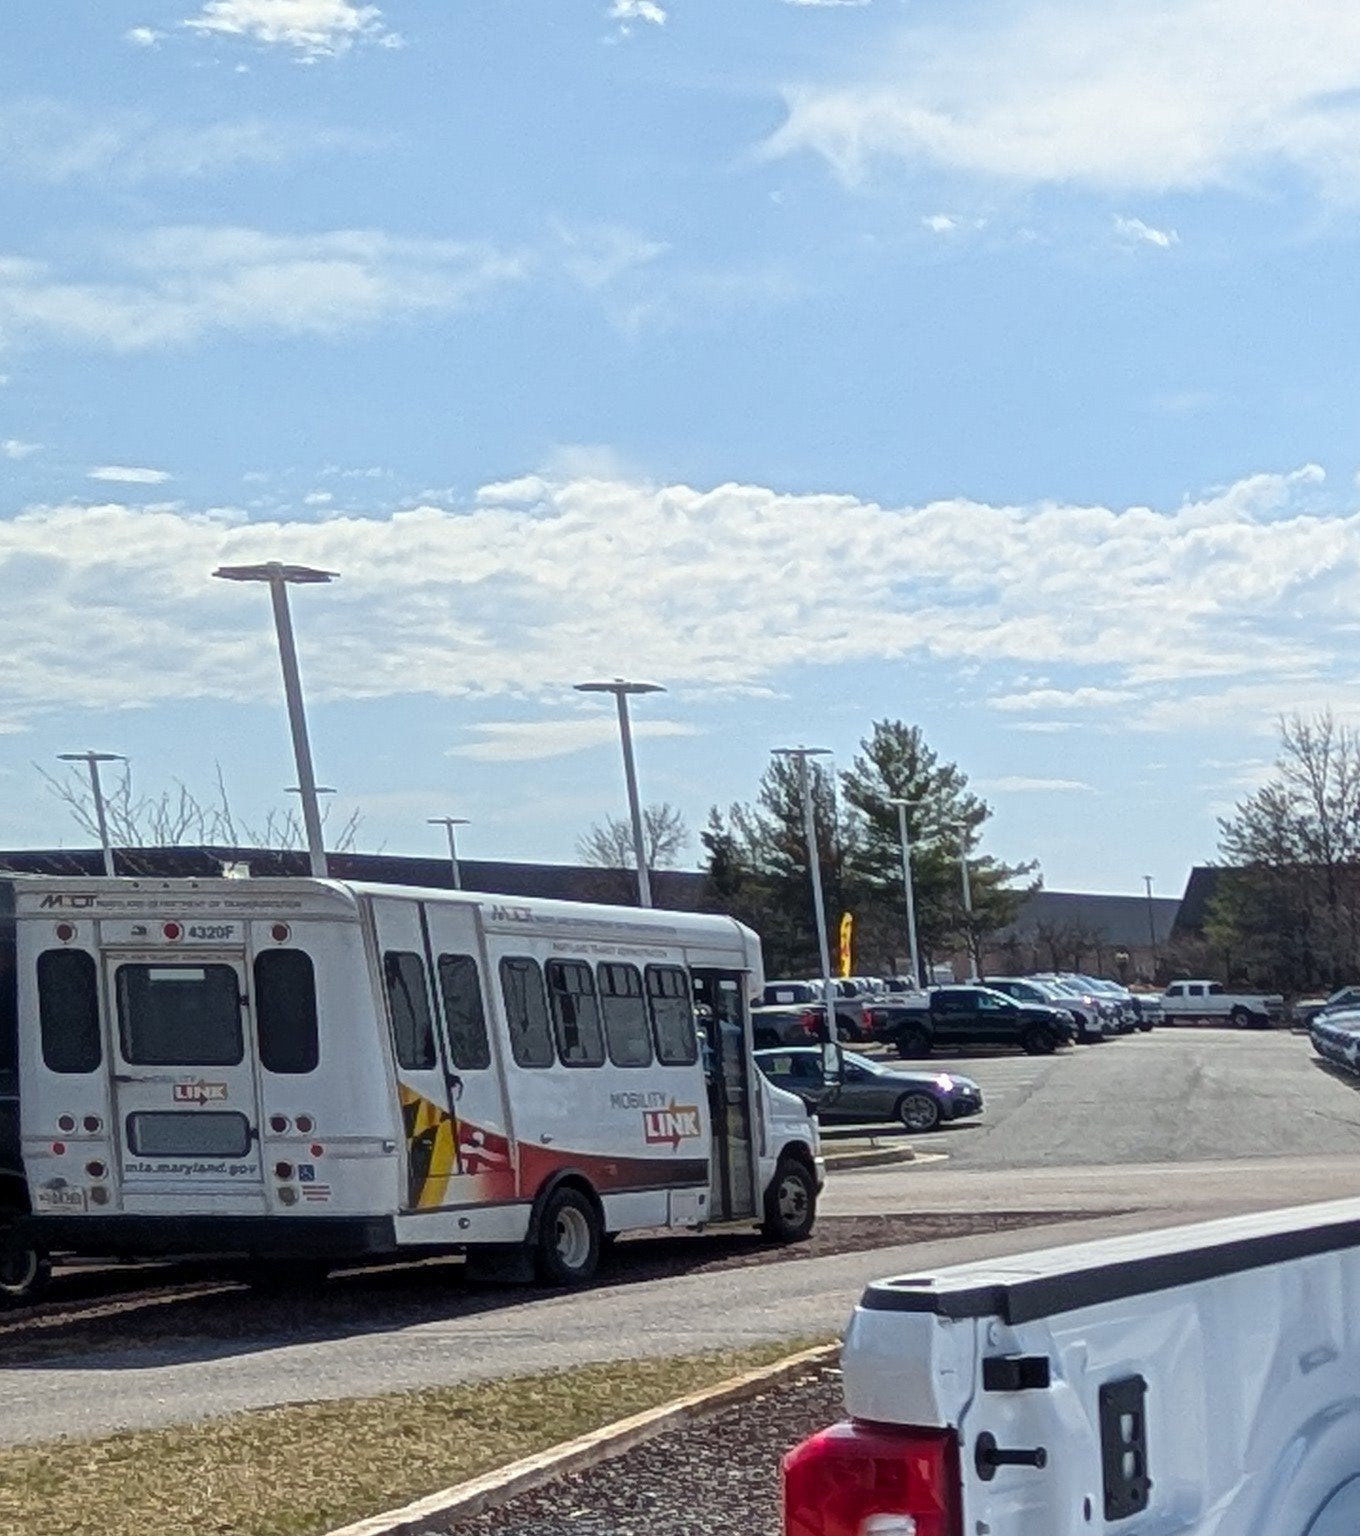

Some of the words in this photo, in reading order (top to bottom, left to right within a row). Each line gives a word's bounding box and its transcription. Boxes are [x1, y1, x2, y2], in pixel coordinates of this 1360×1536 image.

[188, 925, 234, 939] 4320F
[173, 1085, 226, 1100] LINK
[644, 1112, 700, 1137] LINK
